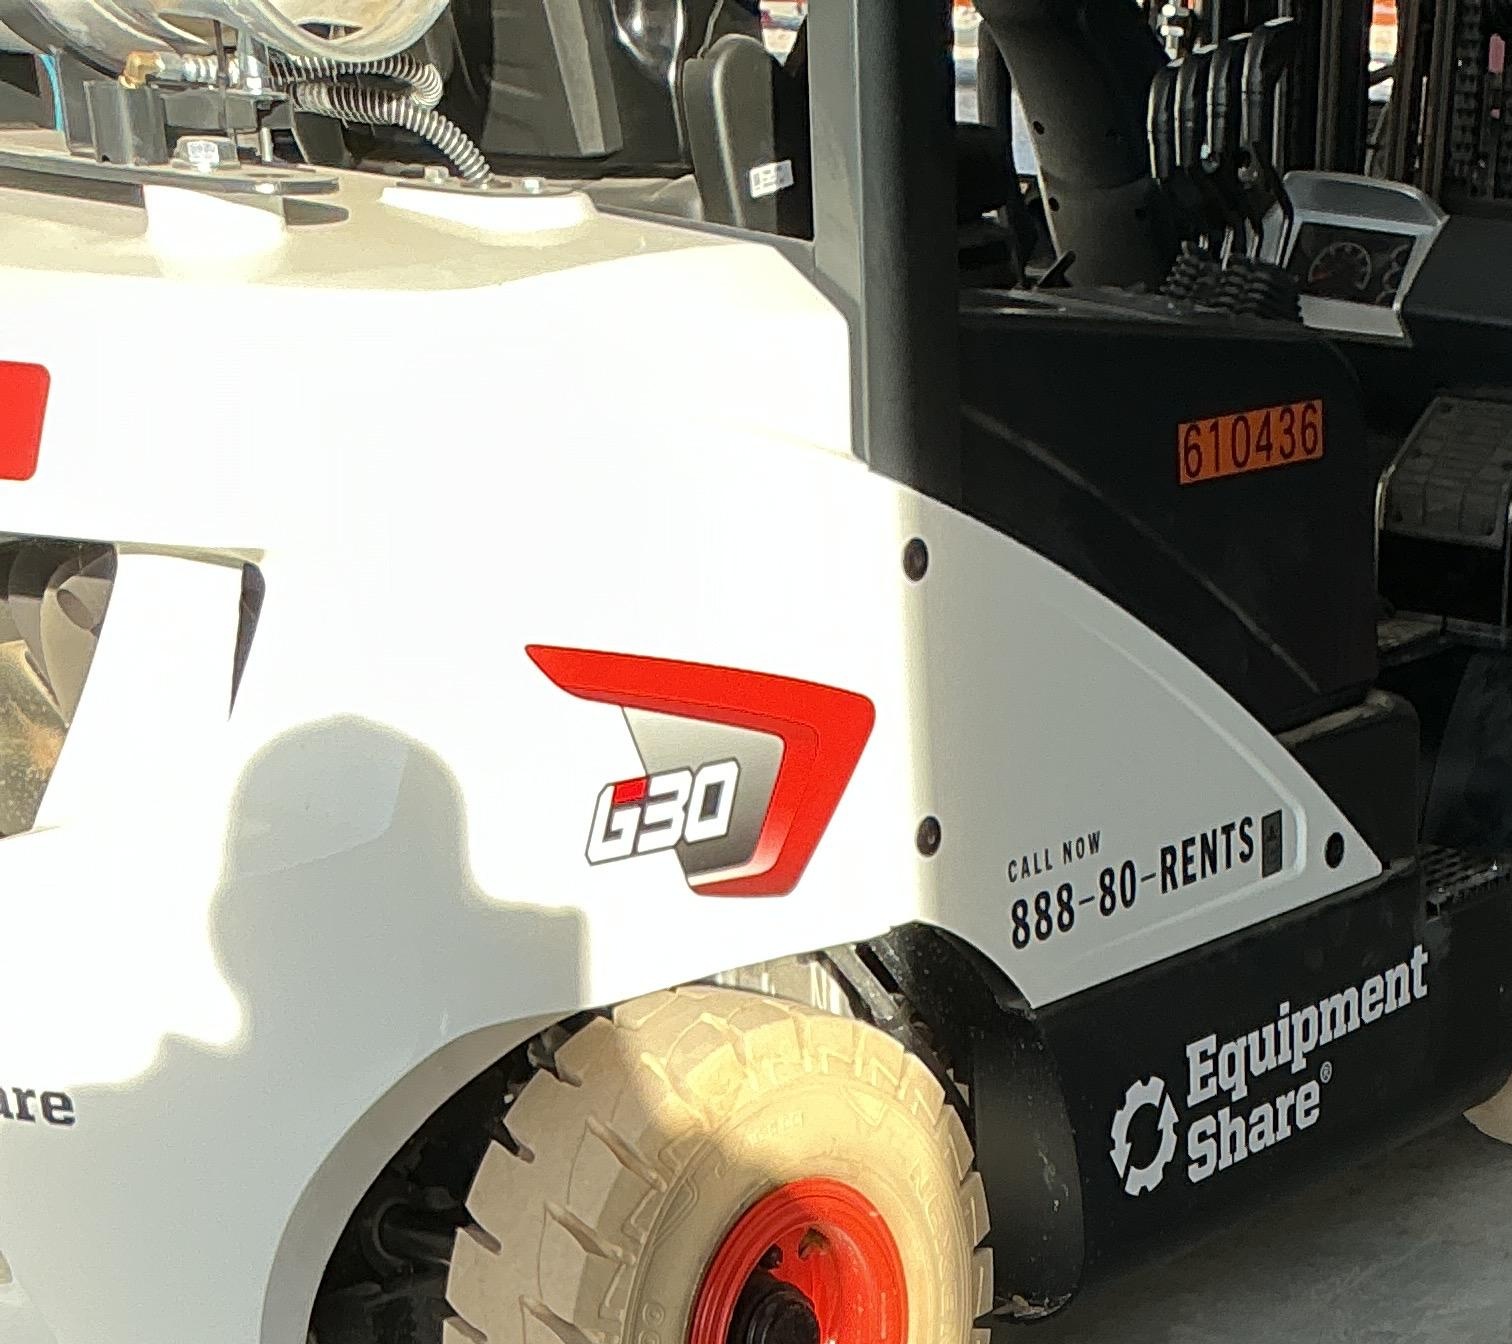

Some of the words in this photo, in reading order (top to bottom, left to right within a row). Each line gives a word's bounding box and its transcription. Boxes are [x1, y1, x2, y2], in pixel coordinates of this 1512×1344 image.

[1183, 403, 1318, 478] 610436
[585, 757, 741, 866] G30
[1007, 848, 1053, 883] CALL
[1062, 830, 1101, 865] NOW
[1011, 815, 1255, 950] 888-80-RENTS
[1186, 944, 1428, 1108] Equipment
